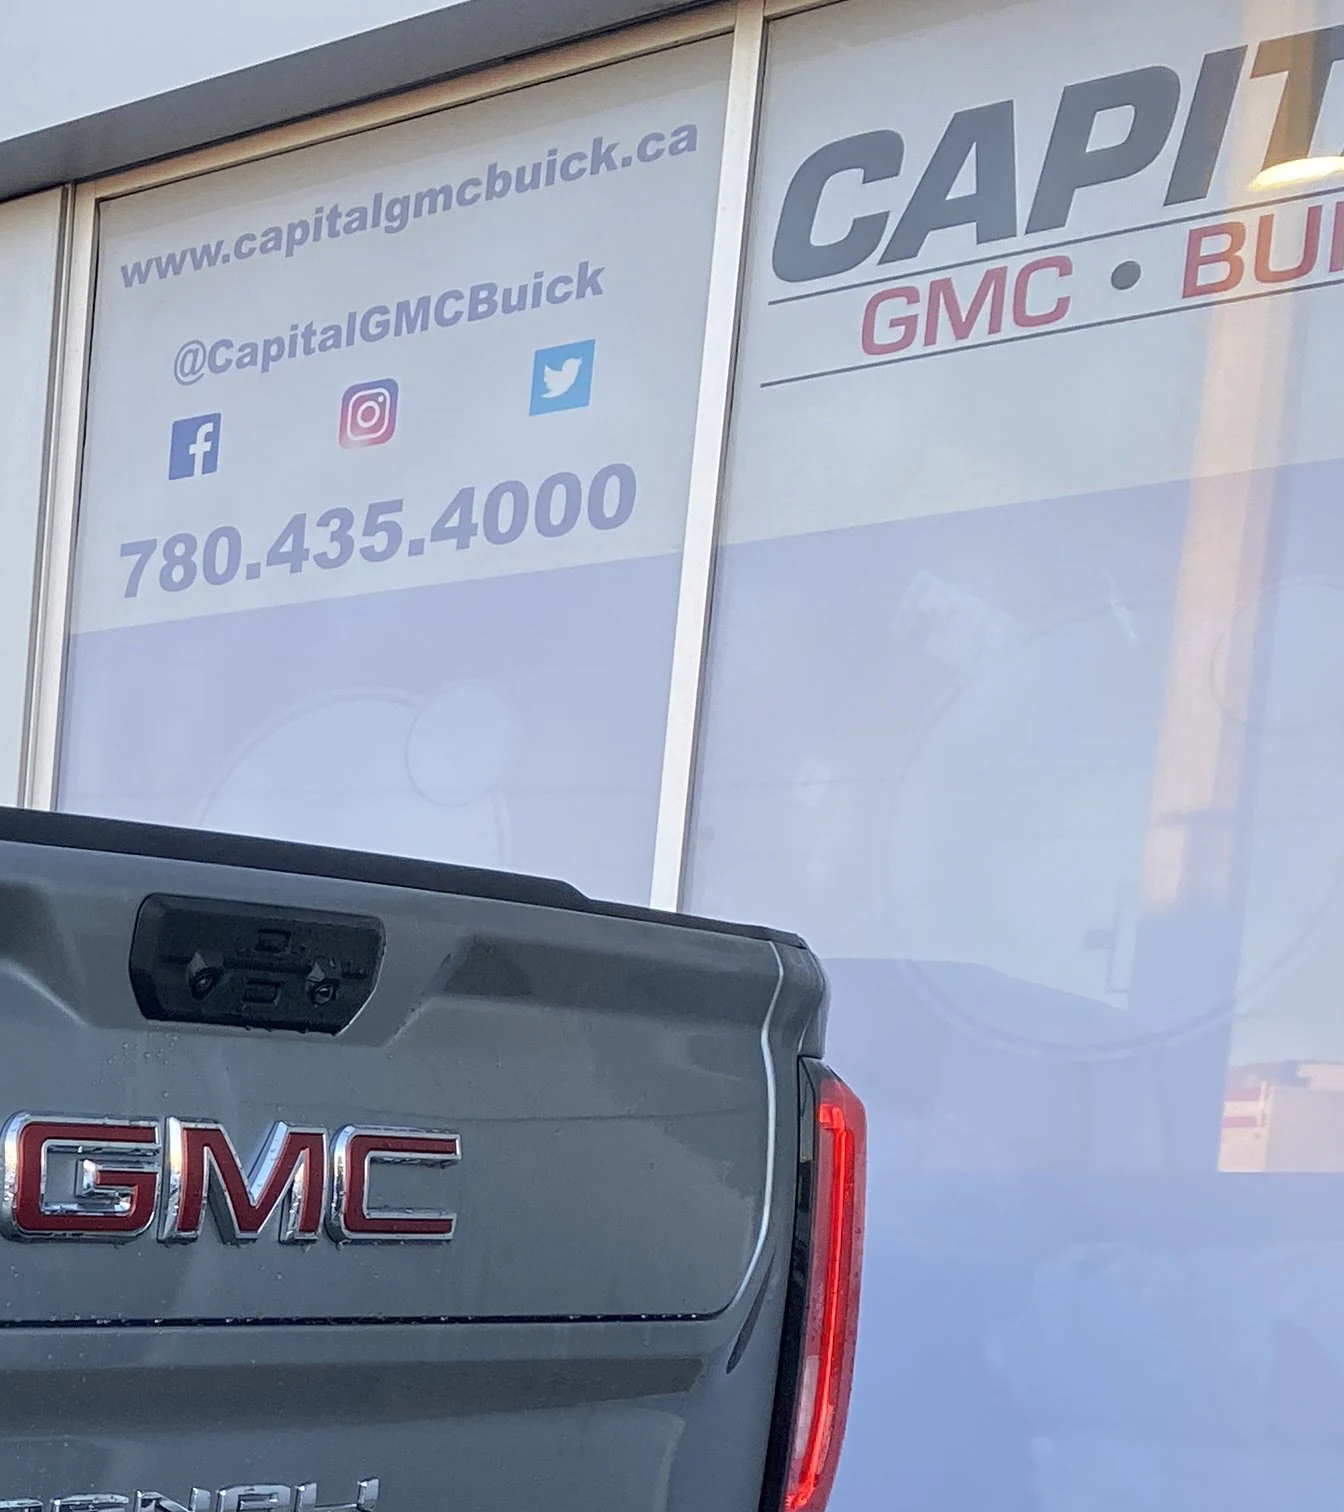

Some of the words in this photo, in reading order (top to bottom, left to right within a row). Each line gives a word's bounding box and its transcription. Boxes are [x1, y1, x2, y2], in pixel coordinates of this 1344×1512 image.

[119, 122, 699, 289] www.capitalgmcbuick.ca
[174, 260, 606, 386] @CapitalGMCBuick
[860, 254, 1074, 356] GMC
[120, 462, 638, 600] 780.435.4000
